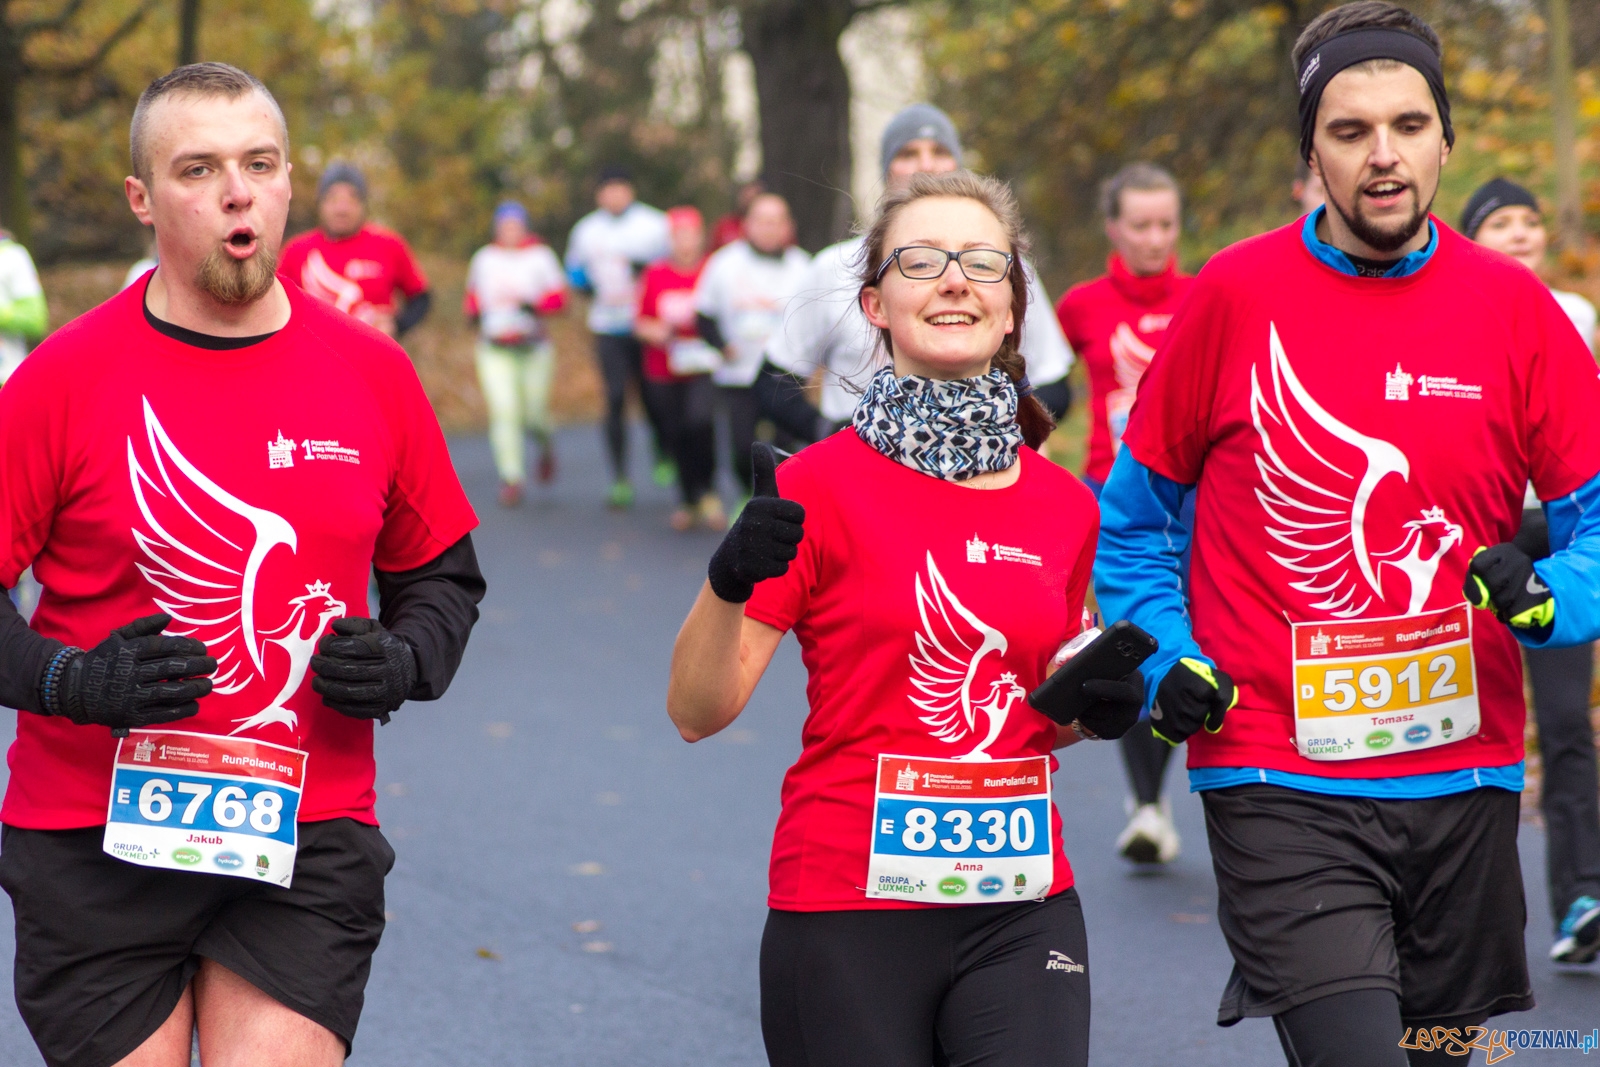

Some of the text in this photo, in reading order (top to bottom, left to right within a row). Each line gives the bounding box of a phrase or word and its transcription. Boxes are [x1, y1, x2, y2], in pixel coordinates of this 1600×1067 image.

[1417, 375, 1430, 396] 1
[301, 439, 315, 460] 1
[992, 543, 1002, 560] 1
[1396, 622, 1460, 642] RunPoland.org
[1334, 635, 1343, 650] 1
[1301, 654, 1458, 712] D 5912
[1371, 714, 1414, 725] Tomasz
[1308, 738, 1337, 746] GRUPA
[159, 745, 167, 760] 1
[1308, 746, 1343, 754] LUXMED
[222, 754, 293, 777] RunPoland.org
[922, 773, 930, 788] 1
[984, 776, 1038, 787] RunPoland.org
[118, 779, 283, 834] E 6768
[881, 807, 1035, 853] E 8330
[186, 834, 223, 845] Jakub
[113, 849, 148, 860] LUXMED
[114, 843, 143, 852] GRUPA
[954, 863, 983, 871] Anna
[879, 876, 909, 884] GRUPA
[878, 884, 914, 893] LUXMED
[1046, 960, 1084, 973] Rogelli
